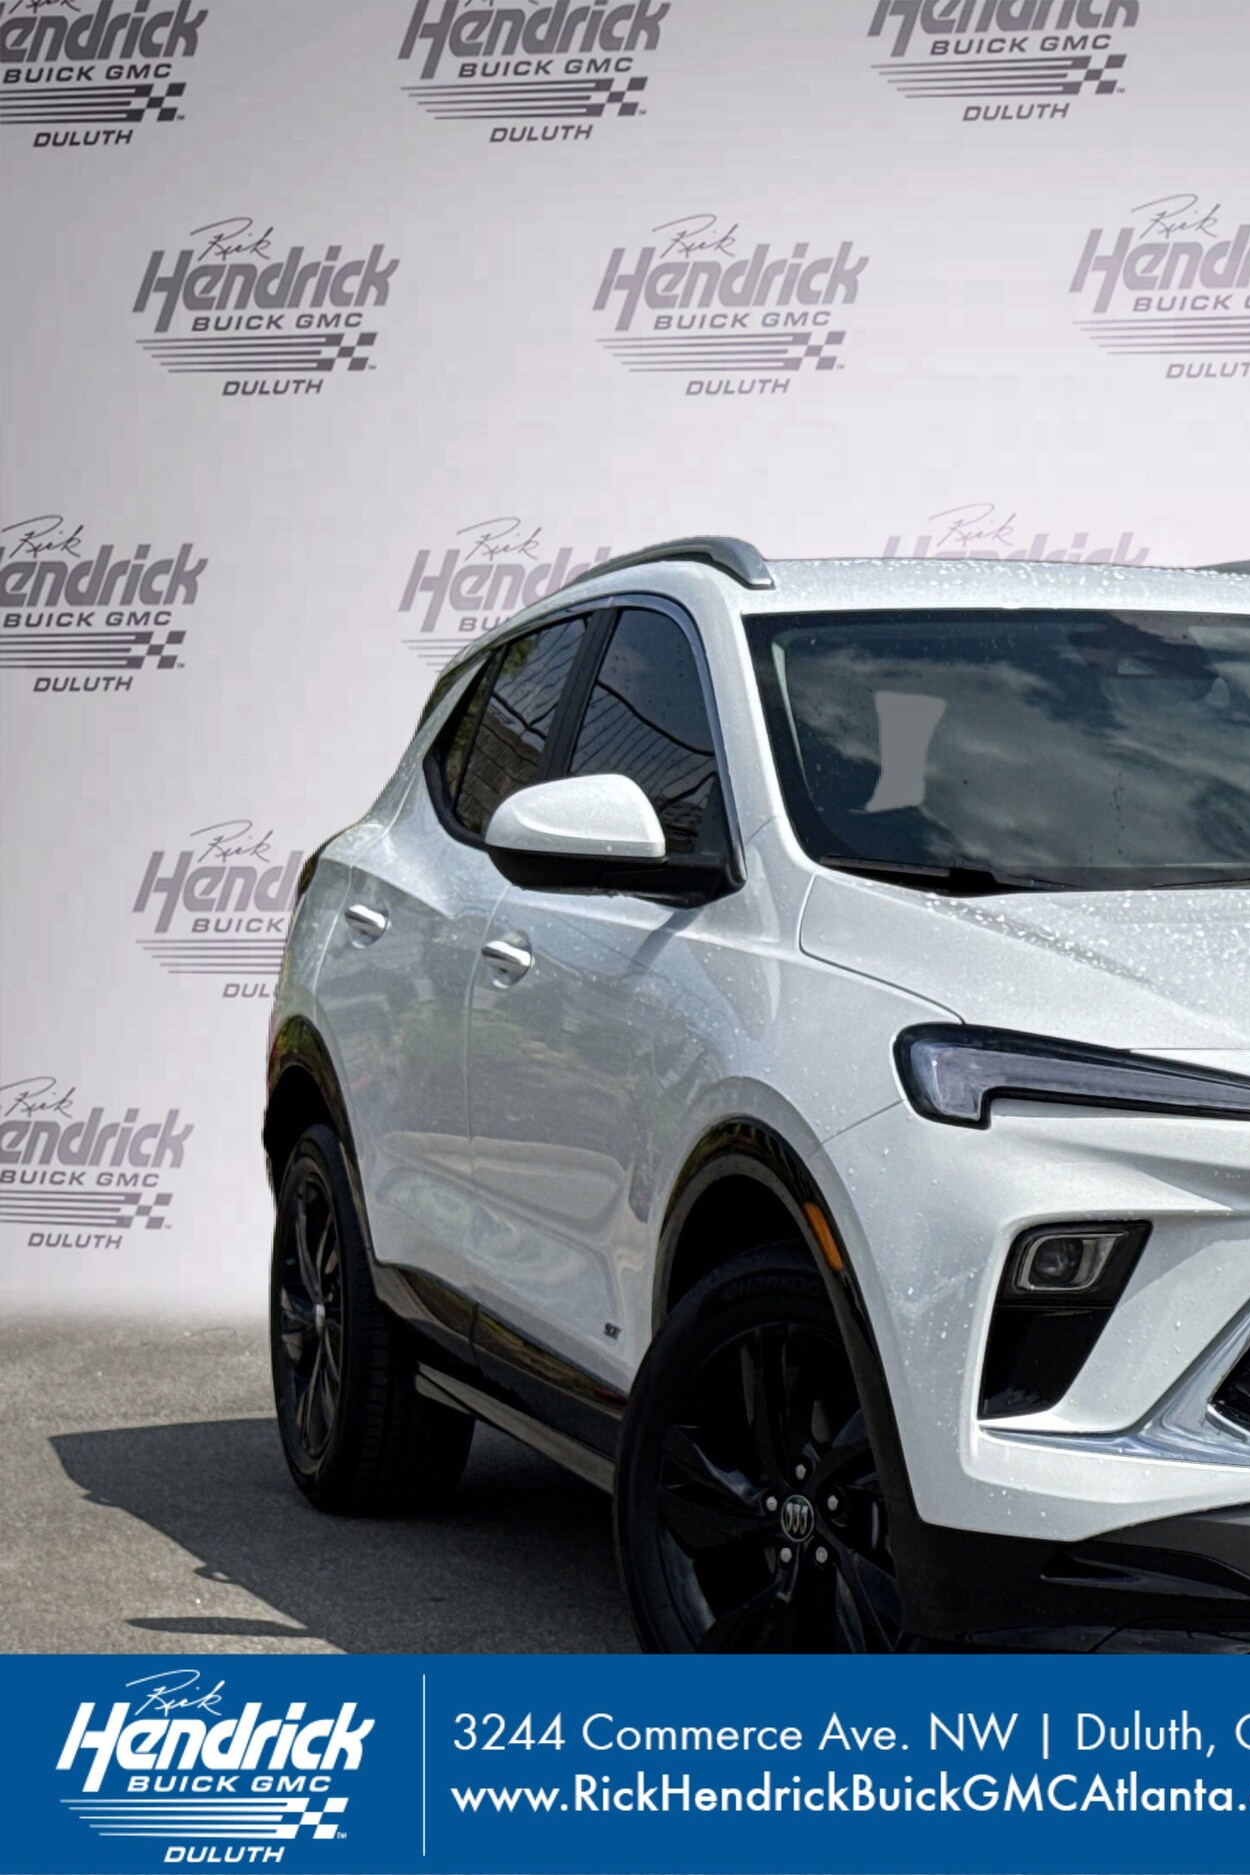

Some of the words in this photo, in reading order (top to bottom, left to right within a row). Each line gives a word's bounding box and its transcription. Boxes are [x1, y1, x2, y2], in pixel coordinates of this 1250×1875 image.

[0, 0, 209, 63] endrick
[397, 0, 671, 79] Hendrick
[929, 37, 1029, 56] BUICK
[1039, 34, 1112, 51] GMC
[3, 65, 95, 84] BUICK
[105, 63, 172, 79] GMC
[458, 59, 554, 78] BUICK
[564, 57, 634, 74] GMC
[962, 103, 1070, 121] DULUTH
[33, 129, 133, 147] DULUTH
[489, 124, 593, 143] DULUTH
[132, 244, 400, 333] Hendrick
[592, 241, 870, 331] Hendrick
[1132, 295, 1233, 312] BUICK
[191, 314, 285, 332] BUICK
[295, 312, 363, 329] GMC
[653, 313, 751, 330] BUICK
[761, 311, 831, 327] GMC
[222, 379, 324, 396] DULUTH
[685, 378, 791, 396] DULUTH
[0, 543, 209, 607] endrick
[398, 547, 612, 633] Hend
[2, 612, 95, 628] BUICK
[105, 611, 172, 627] GMC
[33, 677, 133, 692] DULUTH
[132, 851, 304, 933] Hend
[191, 918, 285, 933] BUICK
[222, 984, 278, 997] DUL
[0, 1107, 195, 1168] endrick
[0, 1170, 87, 1186] BUICK
[96, 1172, 160, 1188] GMC
[27, 1232, 123, 1249] DULUTH
